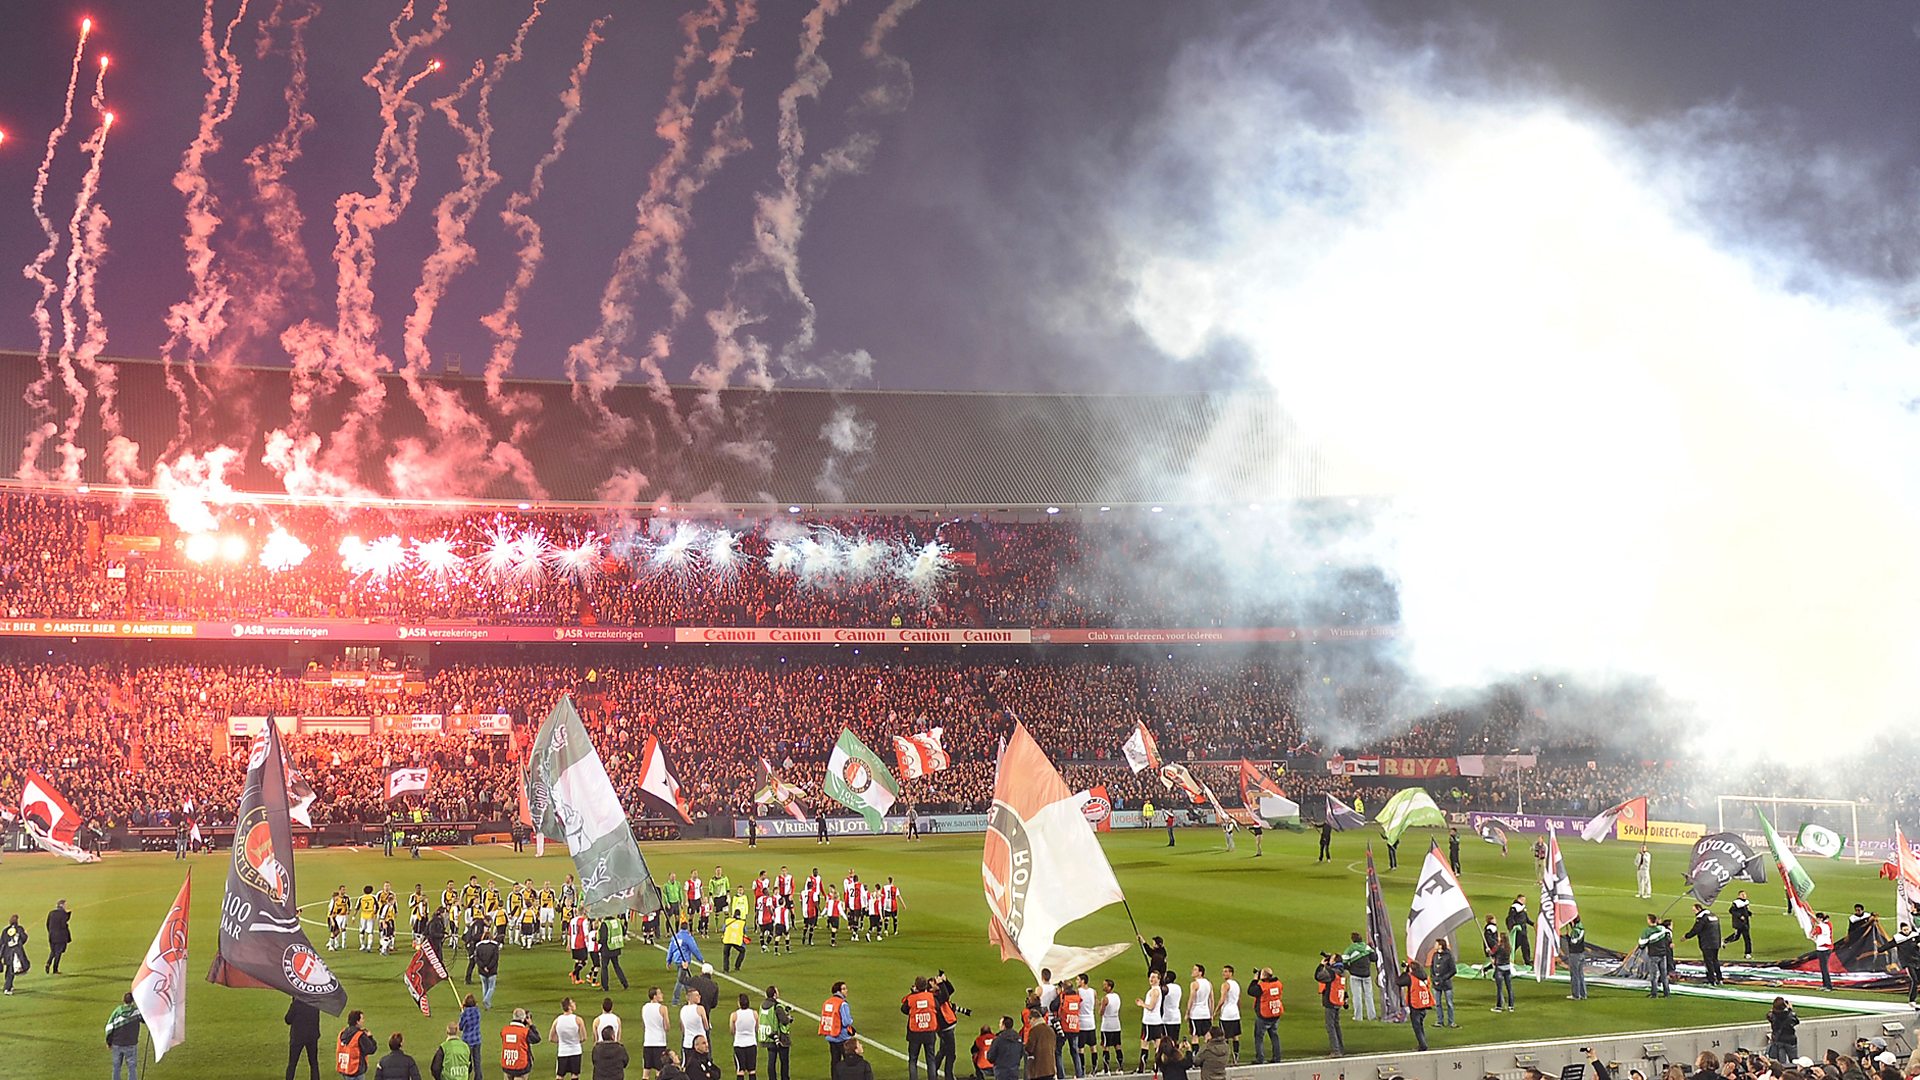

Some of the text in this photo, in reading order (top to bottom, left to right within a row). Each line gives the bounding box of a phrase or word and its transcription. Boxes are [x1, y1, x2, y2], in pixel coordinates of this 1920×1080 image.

[13, 623, 36, 631] BIER
[53, 623, 115, 633] AMSTEL BIER
[132, 624, 193, 635] AMSTEL BIER
[244, 625, 328, 637] ASR verzekeringen
[407, 628, 488, 640] ASR verzekeringen
[564, 628, 643, 640] ASR verzekeringen
[703, 629, 756, 641] Canon
[769, 629, 821, 641] Canon
[834, 629, 886, 641] Canon
[899, 629, 950, 641] Canon
[962, 629, 1012, 641] Canon
[1088, 631, 1109, 640] Club
[1126, 632, 1165, 641] iedereen,
[1187, 631, 1223, 640] iedereen
[1523, 817, 1535, 828] fan
[225, 892, 251, 922] 100
[284, 959, 334, 992] FEYENOORD
[916, 1013, 930, 1022] FOTO
[1711, 1040, 1720, 1048] 34
[504, 1050, 518, 1060] FOTO
[1453, 1062, 1462, 1070] 36
